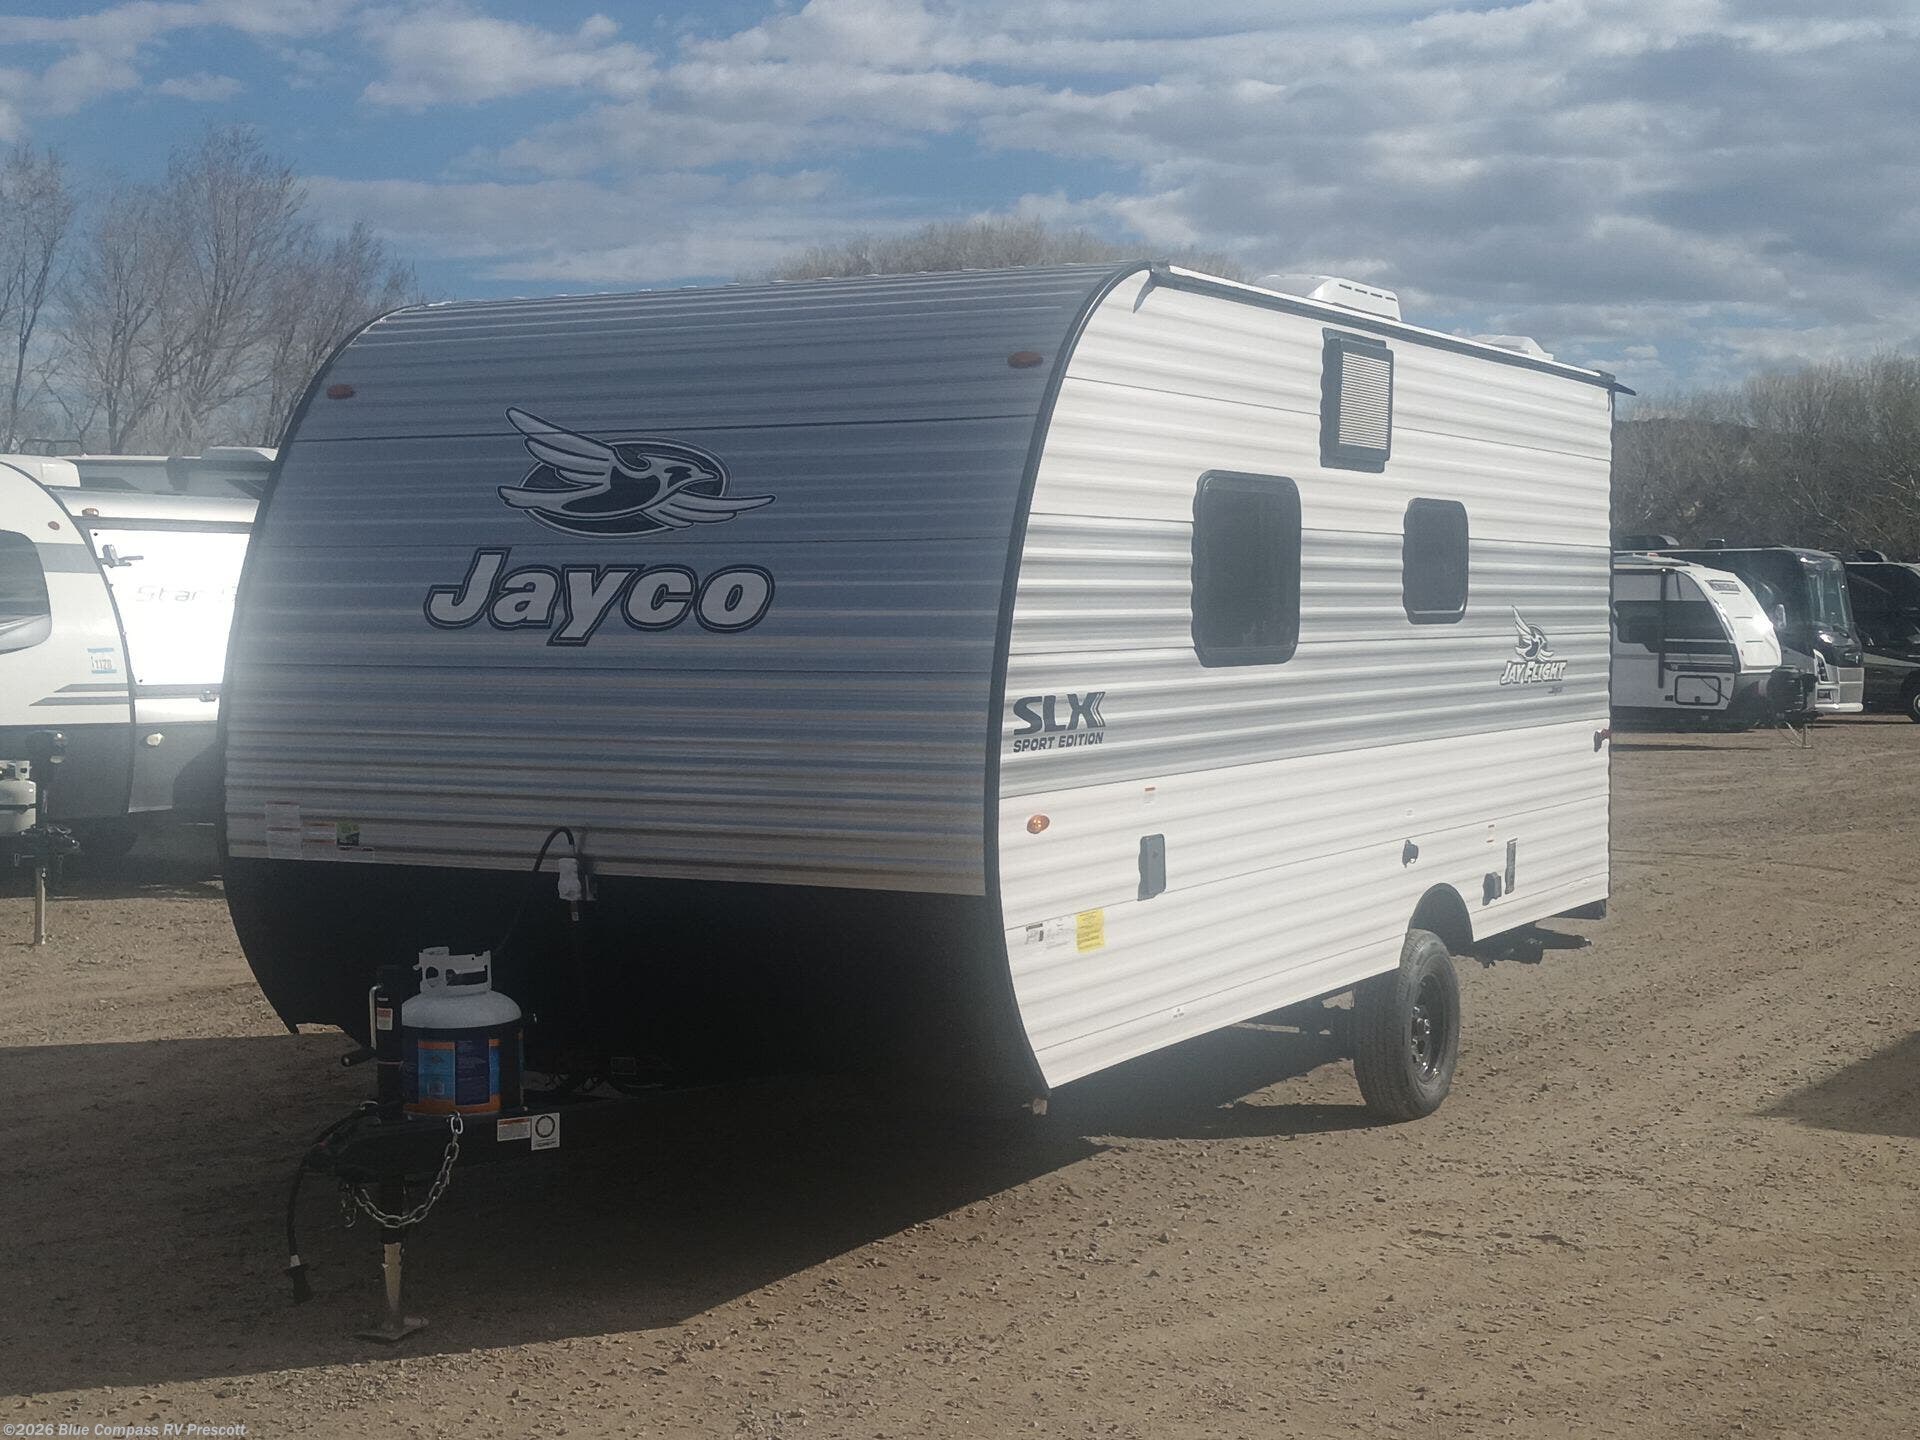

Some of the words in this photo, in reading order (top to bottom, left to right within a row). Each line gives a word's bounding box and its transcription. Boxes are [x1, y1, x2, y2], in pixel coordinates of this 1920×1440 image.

[423, 547, 775, 647] Jayco
[1500, 660, 1526, 685] JAY
[1524, 660, 1568, 684] FLIGHT
[1013, 691, 1106, 735] SLX
[1013, 736, 1055, 753] SPORT
[1058, 732, 1104, 748] EDITION
